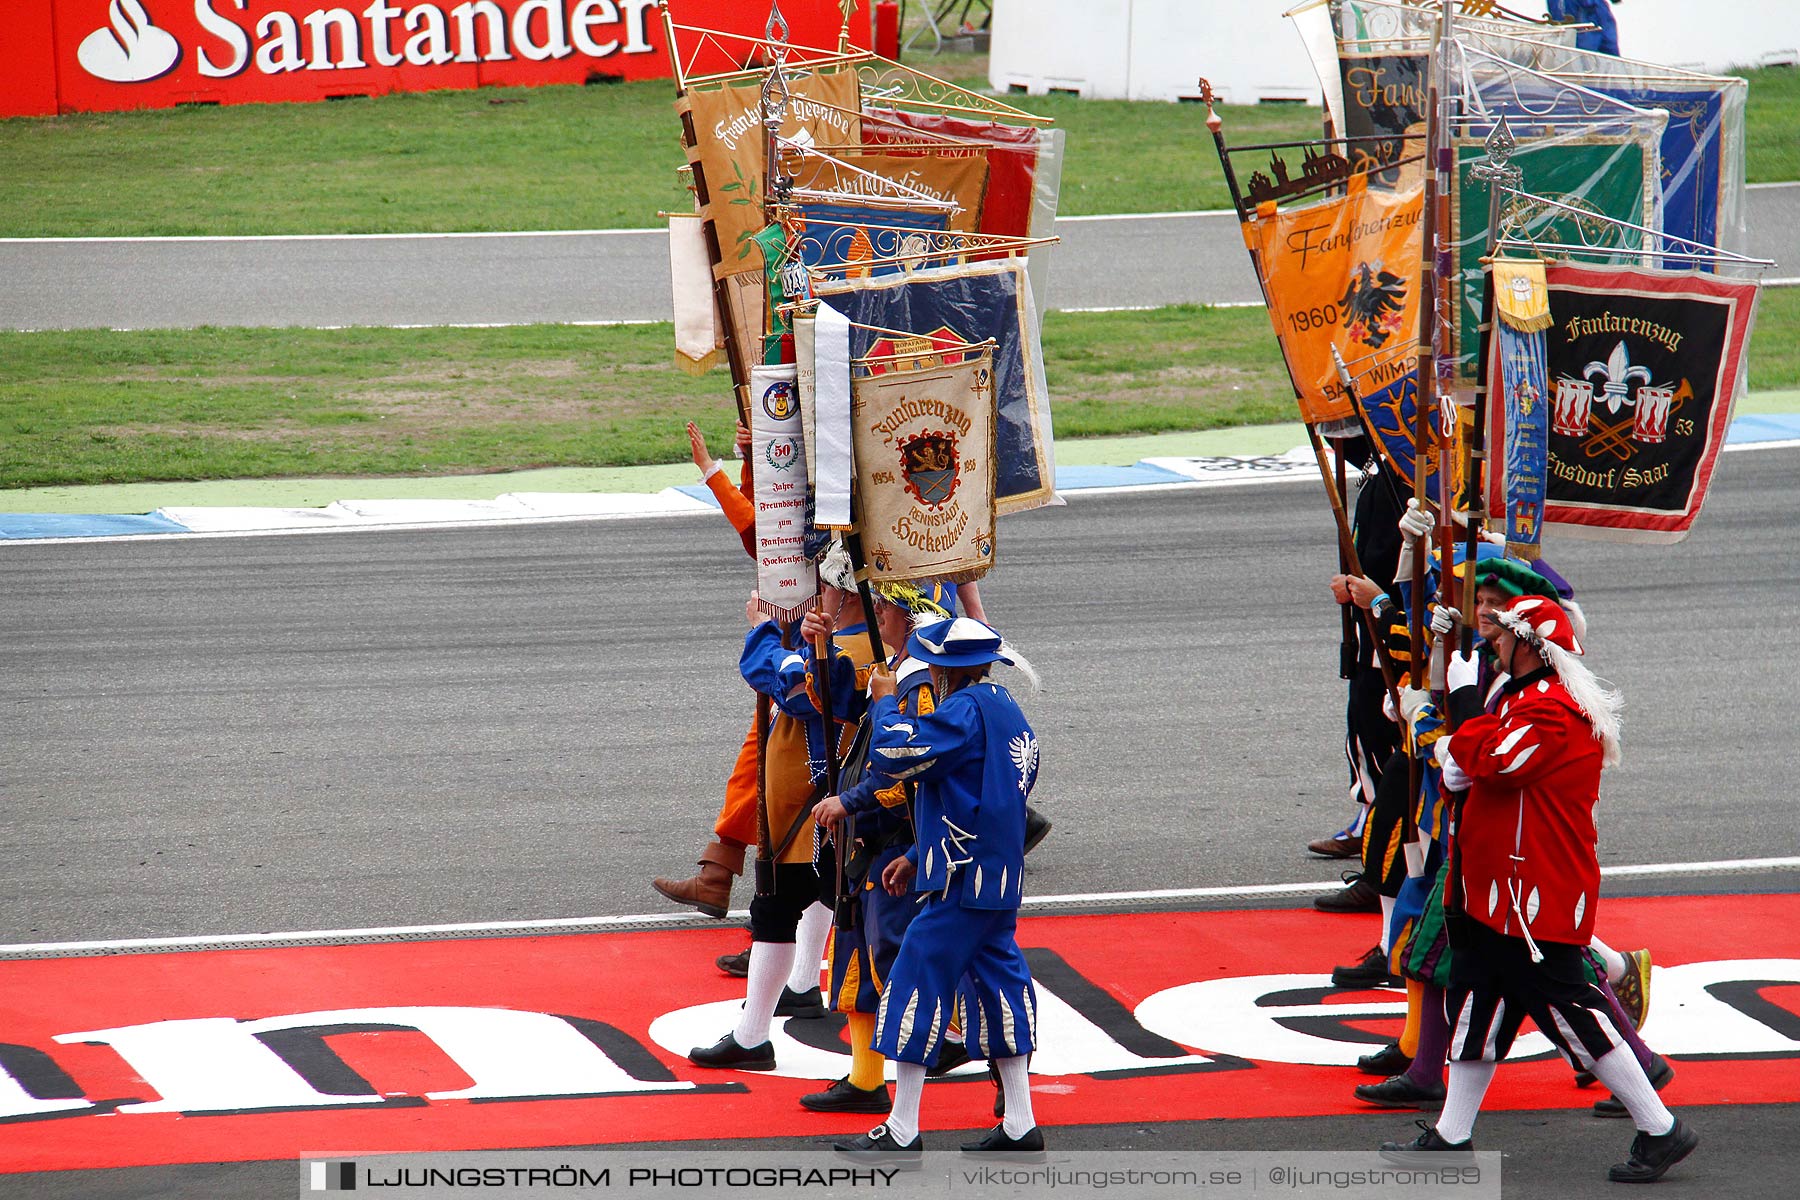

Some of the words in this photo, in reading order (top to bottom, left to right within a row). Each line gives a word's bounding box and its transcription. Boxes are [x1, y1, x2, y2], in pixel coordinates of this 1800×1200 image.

[196, 0, 657, 77] Santander
[1288, 304, 1338, 333] 1960
[1565, 311, 1684, 353] Fanfarenzug
[1674, 418, 1695, 437] 53
[774, 444, 791, 458] 50
[772, 482, 794, 492] Jahre
[909, 499, 961, 527] RENNSTADT
[891, 510, 969, 553] Hockenheim
[762, 554, 805, 567] Hockenhei
[779, 578, 797, 588] 2004
